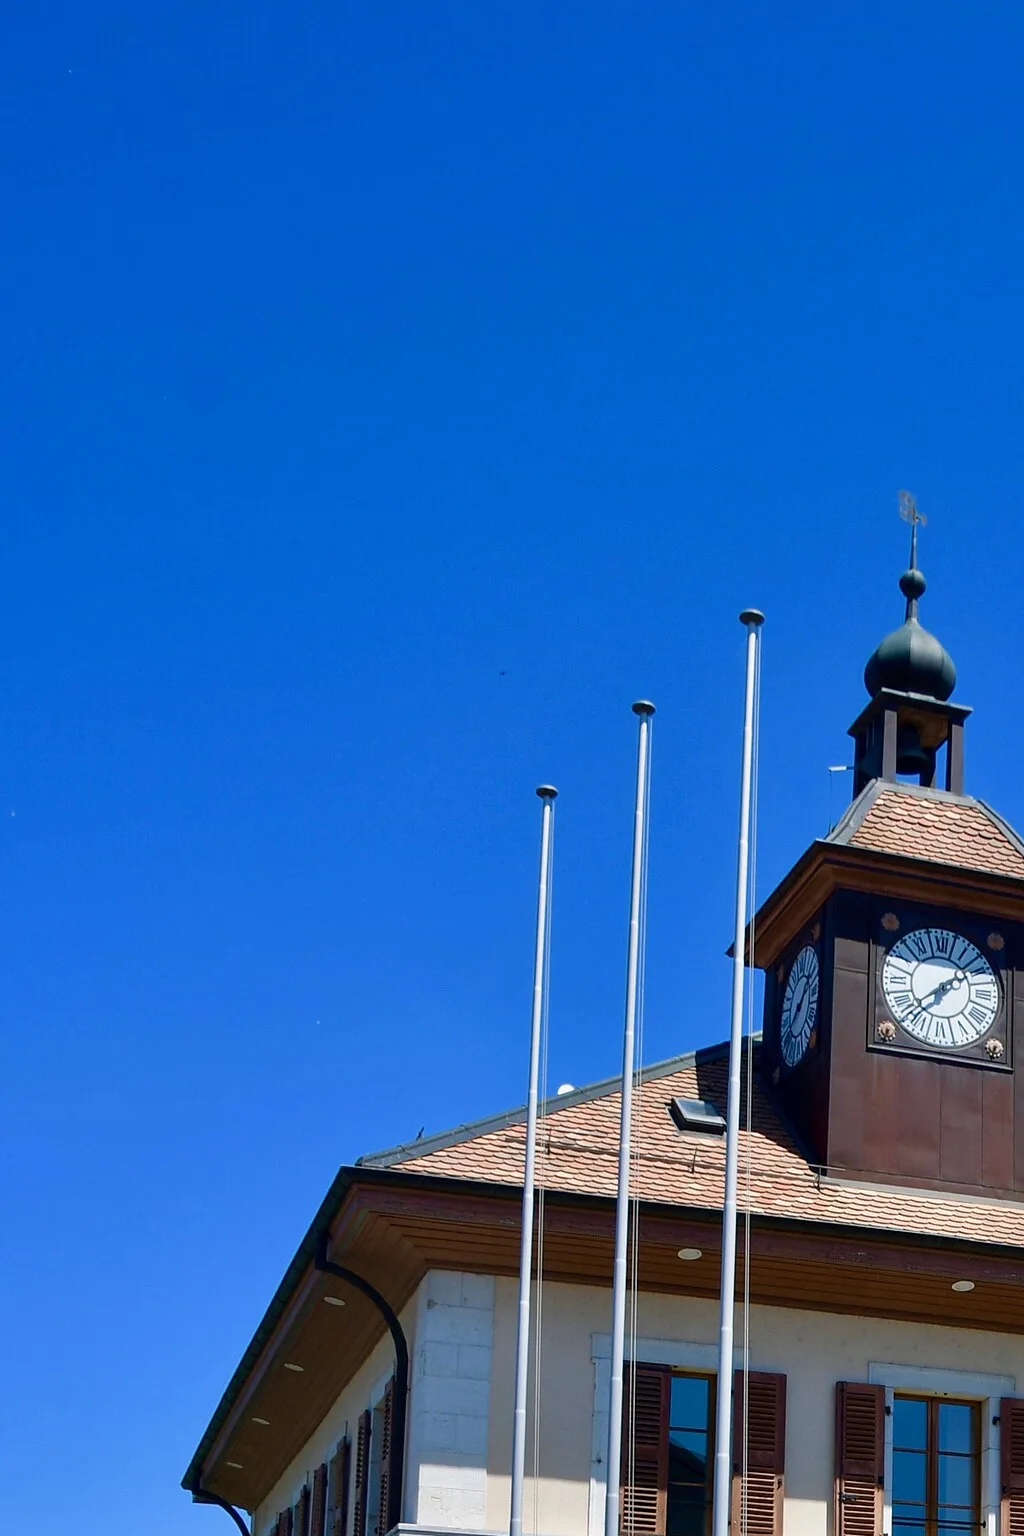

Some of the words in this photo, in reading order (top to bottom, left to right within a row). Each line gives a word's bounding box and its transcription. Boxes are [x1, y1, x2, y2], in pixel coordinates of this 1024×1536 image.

[912, 936, 927, 956] XI
[934, 936, 948, 954] XII
[976, 989, 992, 1002] III
[968, 1006, 987, 1026] IIII
